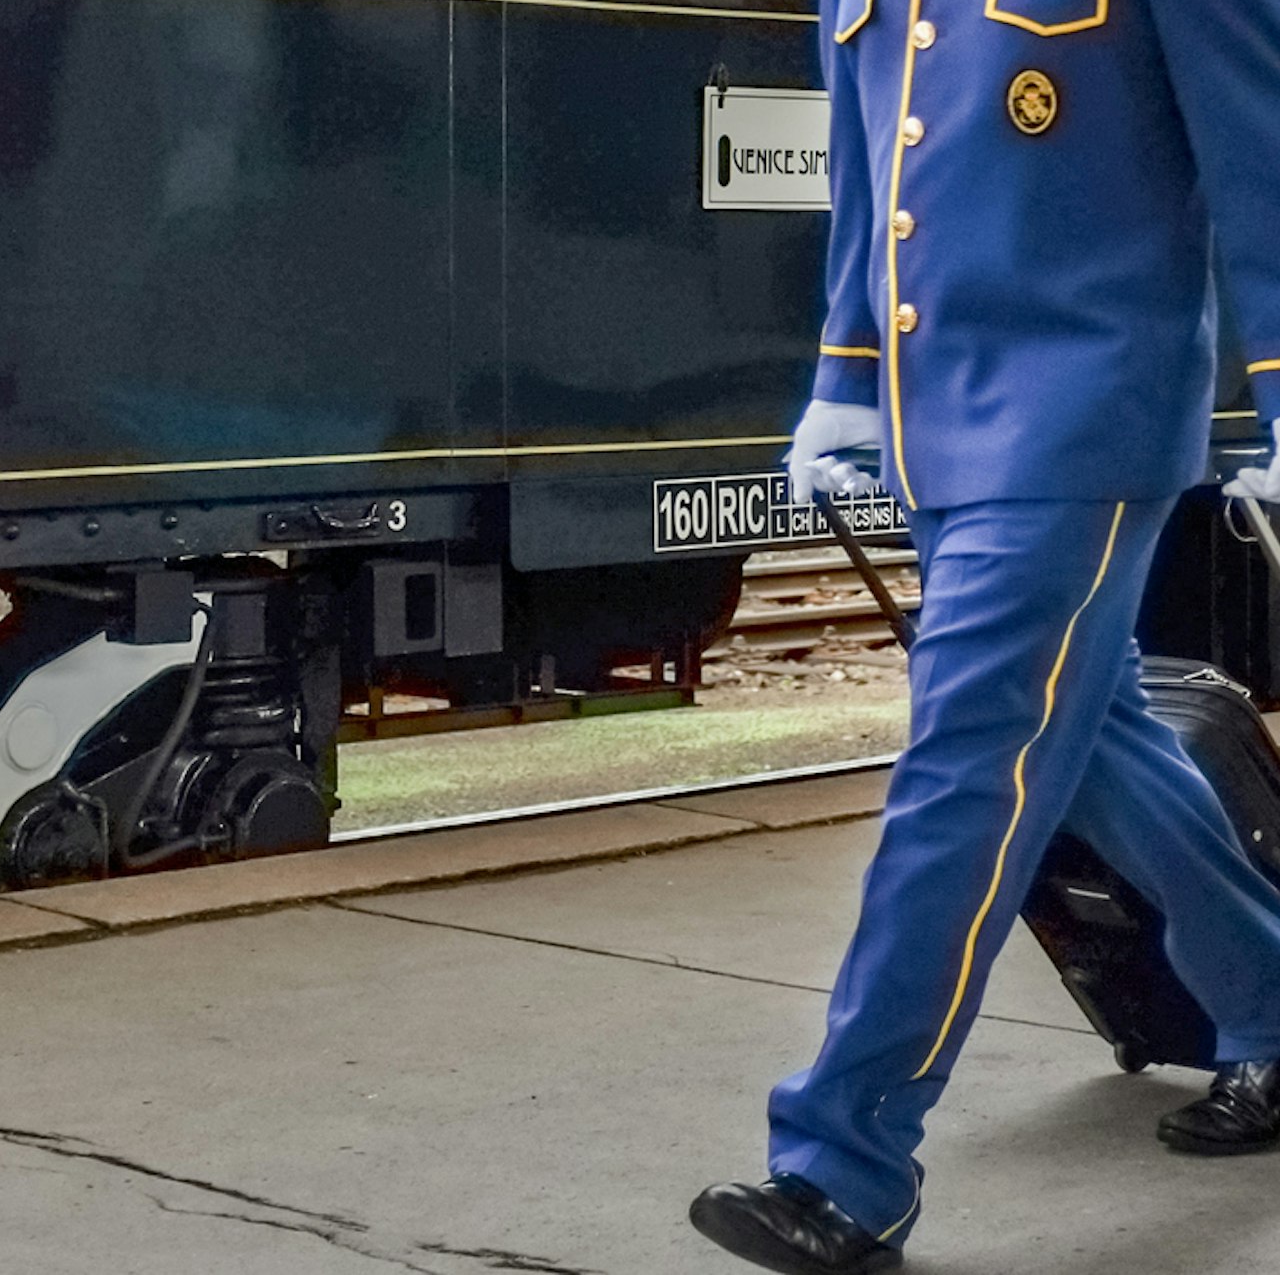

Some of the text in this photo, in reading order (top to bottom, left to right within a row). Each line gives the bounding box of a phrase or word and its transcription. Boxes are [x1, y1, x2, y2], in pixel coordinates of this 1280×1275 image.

[733, 148, 794, 175] VENICE
[775, 481, 785, 501] F
[387, 499, 407, 532] 3
[659, 488, 708, 541] 160
[718, 482, 766, 537] RIC
[776, 514, 786, 534] L
[792, 511, 810, 532] CH
[854, 507, 871, 527] CS
